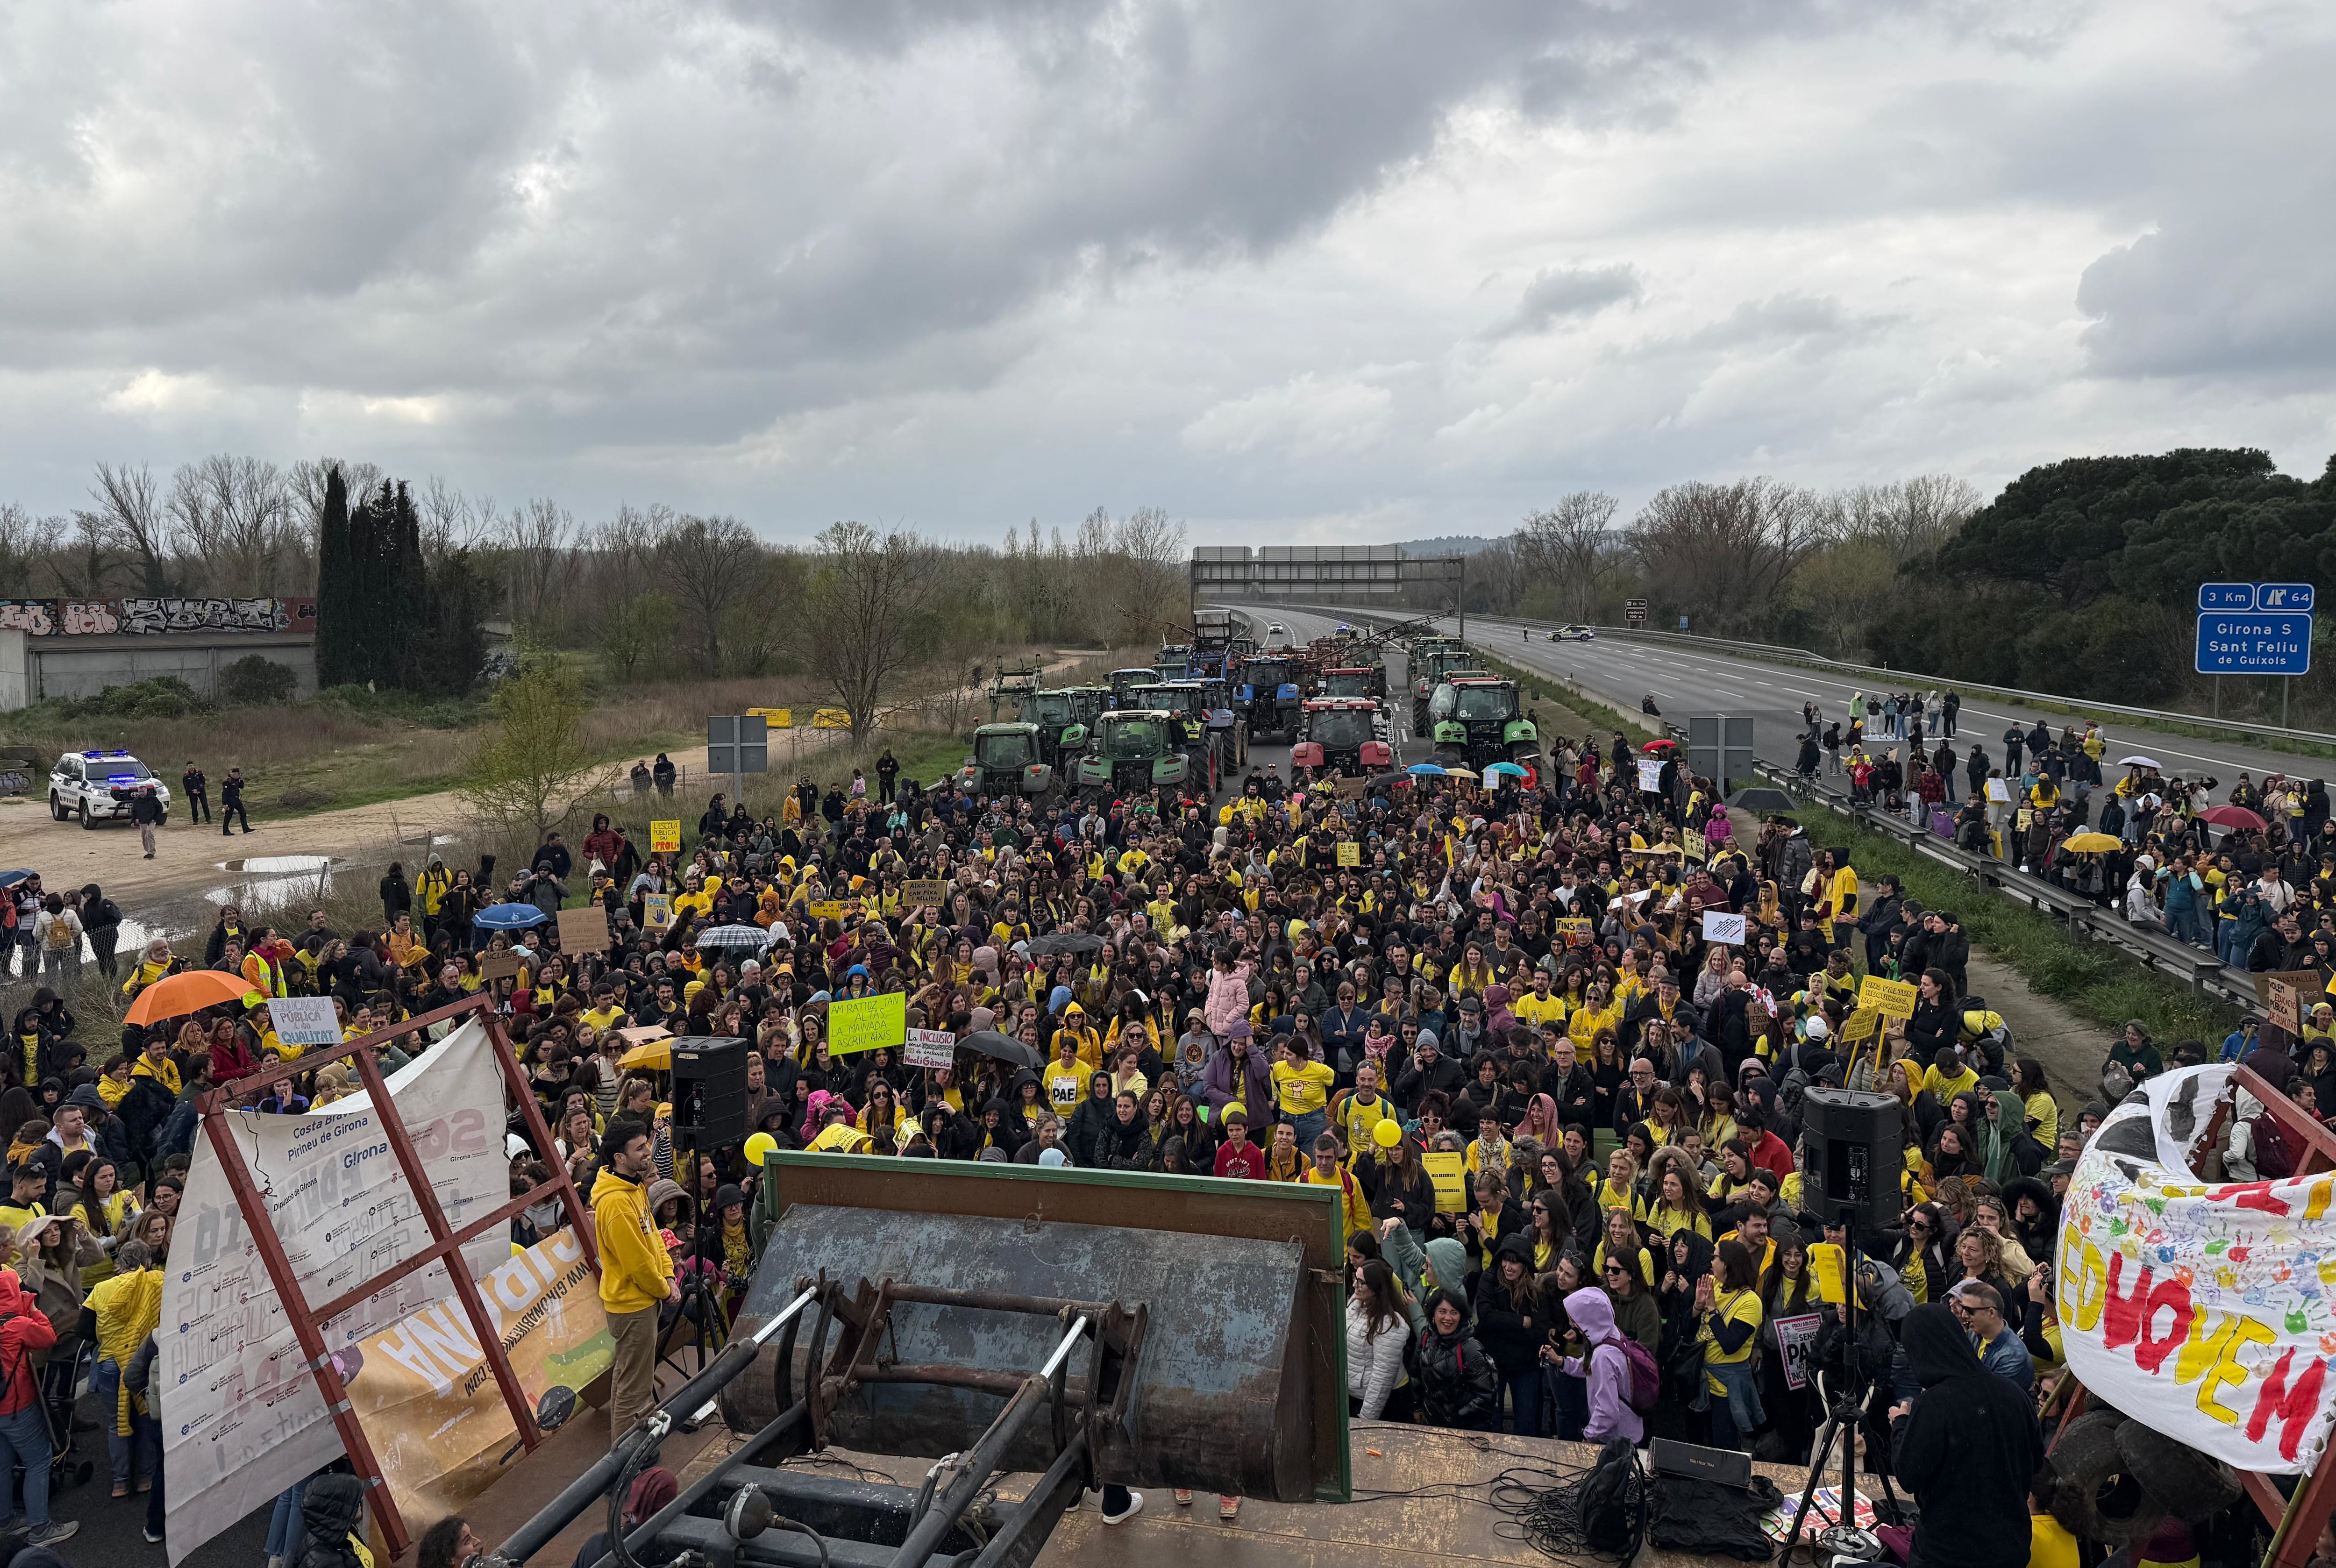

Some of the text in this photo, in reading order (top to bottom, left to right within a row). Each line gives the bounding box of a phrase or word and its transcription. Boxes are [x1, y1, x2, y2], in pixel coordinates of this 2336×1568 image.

[2208, 592, 2246, 602] 3 Km
[2292, 593, 2309, 602] 64
[2217, 623, 2292, 635] Girona S
[2209, 641, 2298, 653] Sant Feliu
[1557, 920, 1575, 930] FINS
[1866, 981, 1913, 997] ENS FALTEN
[2269, 982, 2285, 994] VOLEM
[272, 998, 326, 1012] EDUCACIÓ
[831, 1005, 843, 1014] AM
[883, 996, 899, 1007] TAN
[2270, 1011, 2275, 1021] DE
[832, 1027, 843, 1037] LA
[908, 1029, 918, 1041] La
[837, 1034, 866, 1048] ASCRIU
[1053, 1088, 1075, 1101] PAE
[293, 1120, 322, 1139] Costa
[288, 1117, 368, 1162] Pirineu de Girona
[1225, 1158, 1238, 1167] SPORT
[273, 1193, 294, 1212] Diputació
[1786, 1340, 1815, 1365] PA
[1791, 1371, 1806, 1381] INCL
